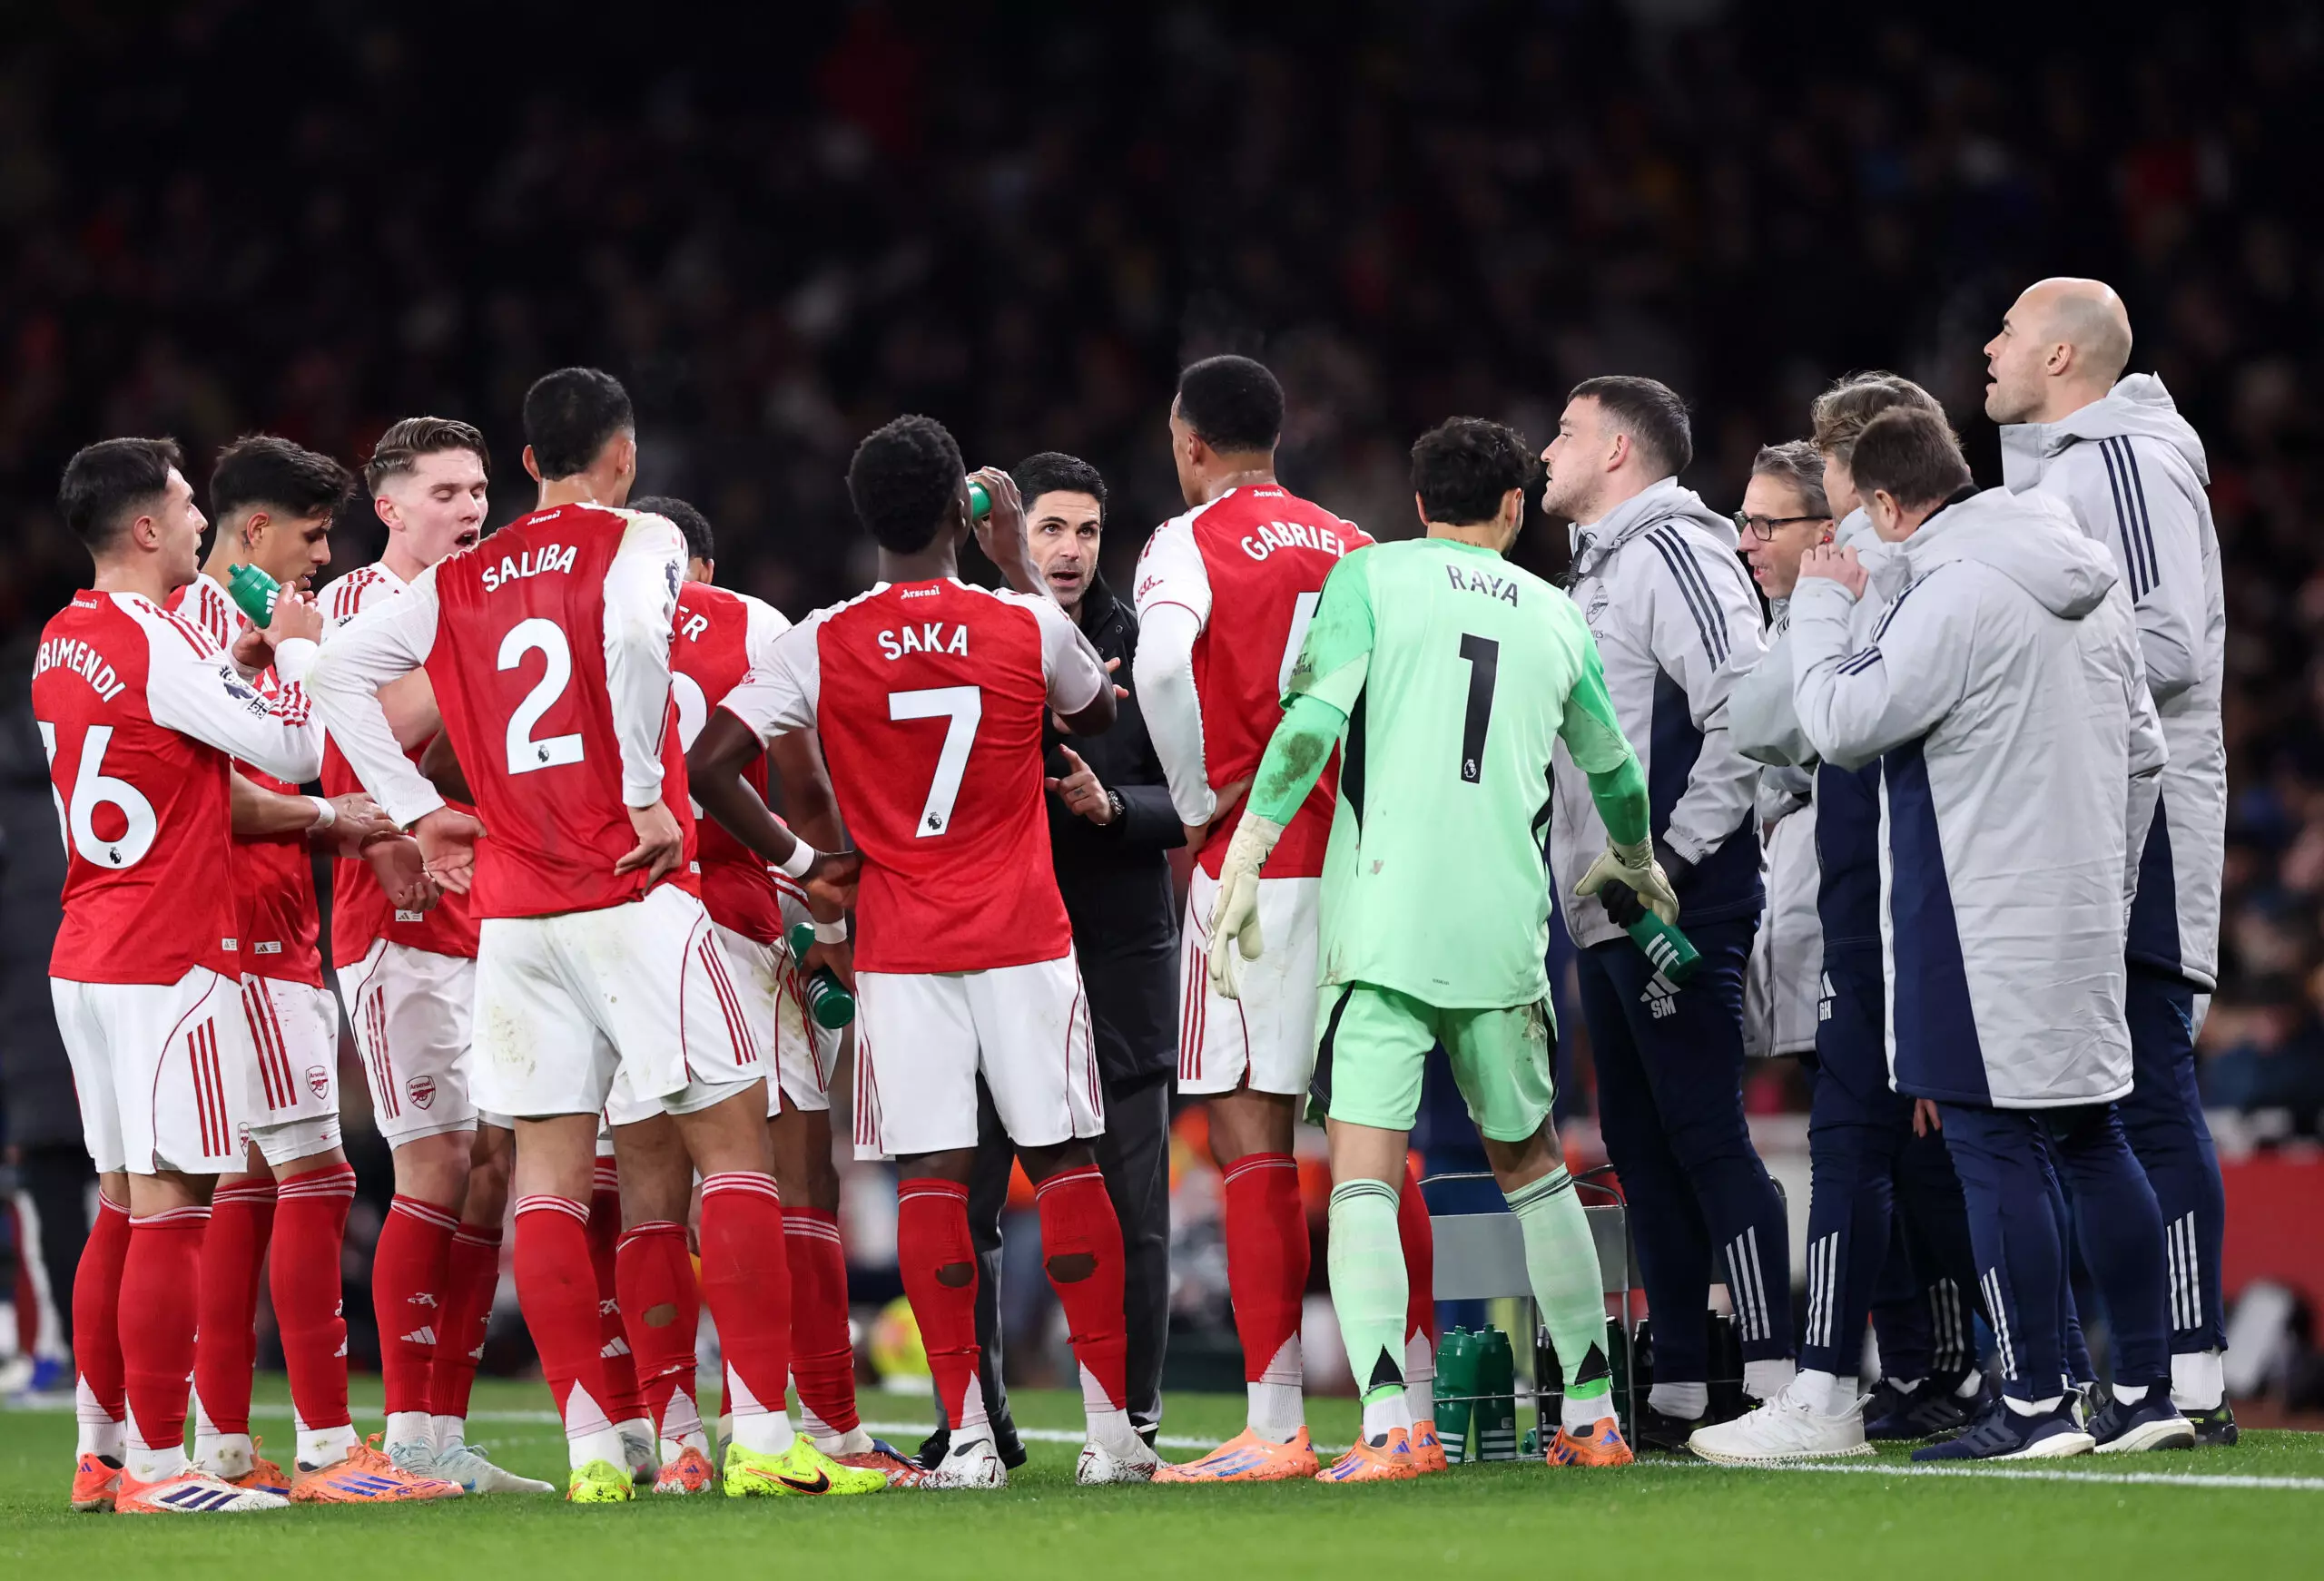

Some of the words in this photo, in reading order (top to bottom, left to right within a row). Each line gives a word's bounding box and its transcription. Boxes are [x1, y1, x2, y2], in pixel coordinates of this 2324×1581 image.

[527, 510, 560, 525] Arsenal
[481, 543, 577, 593] SALIBA
[901, 584, 940, 600] Arsenal
[1446, 565, 1518, 608] RAYA
[877, 622, 969, 661] SAKA
[497, 617, 585, 775] 2
[1459, 633, 1500, 784] 1
[888, 685, 982, 838] 7
[1650, 995, 1677, 1019] SM
[1819, 999, 1832, 1021] GH
[310, 1070, 326, 1078] Arsenal
[410, 1080, 431, 1089] Arsenal
